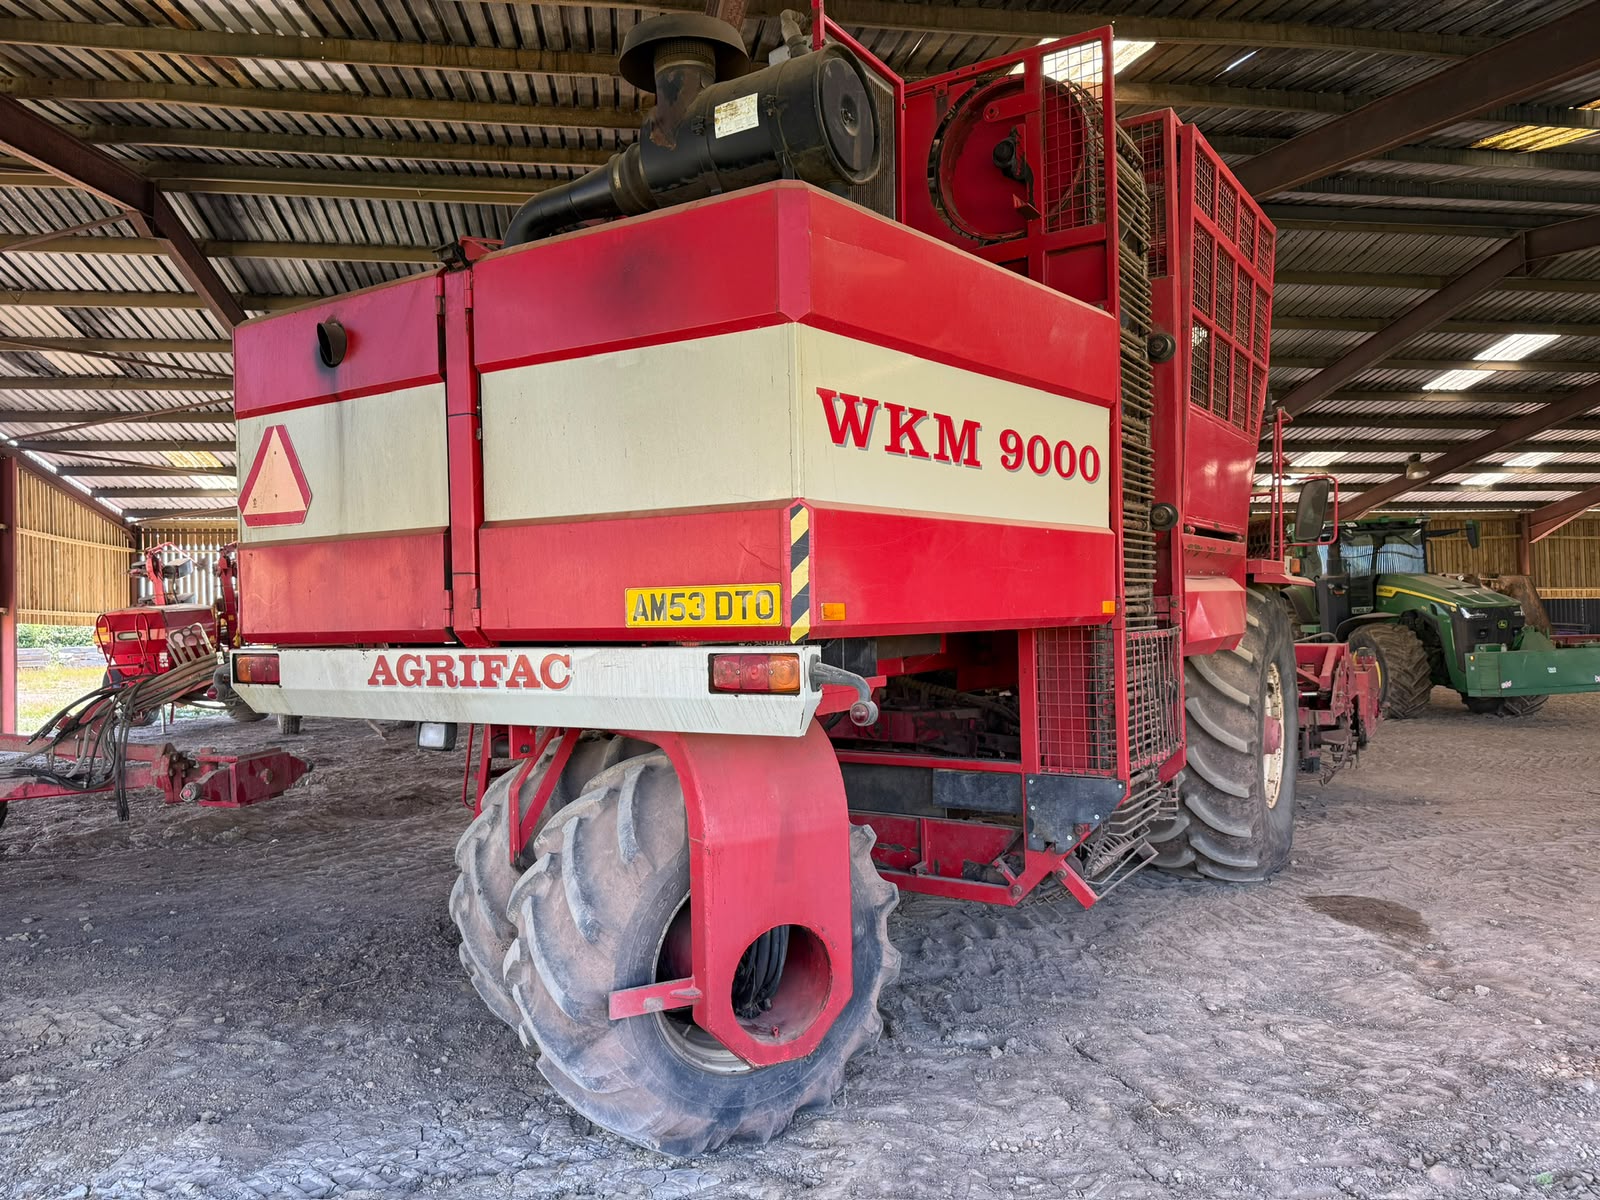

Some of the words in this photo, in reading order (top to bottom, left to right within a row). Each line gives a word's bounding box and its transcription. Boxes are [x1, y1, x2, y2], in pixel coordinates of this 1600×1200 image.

[815, 386, 983, 470] WKM
[999, 428, 1101, 484] 9000
[632, 591, 706, 622] AM53
[714, 589, 775, 621] DTO
[367, 653, 573, 690] AGRIFAC
